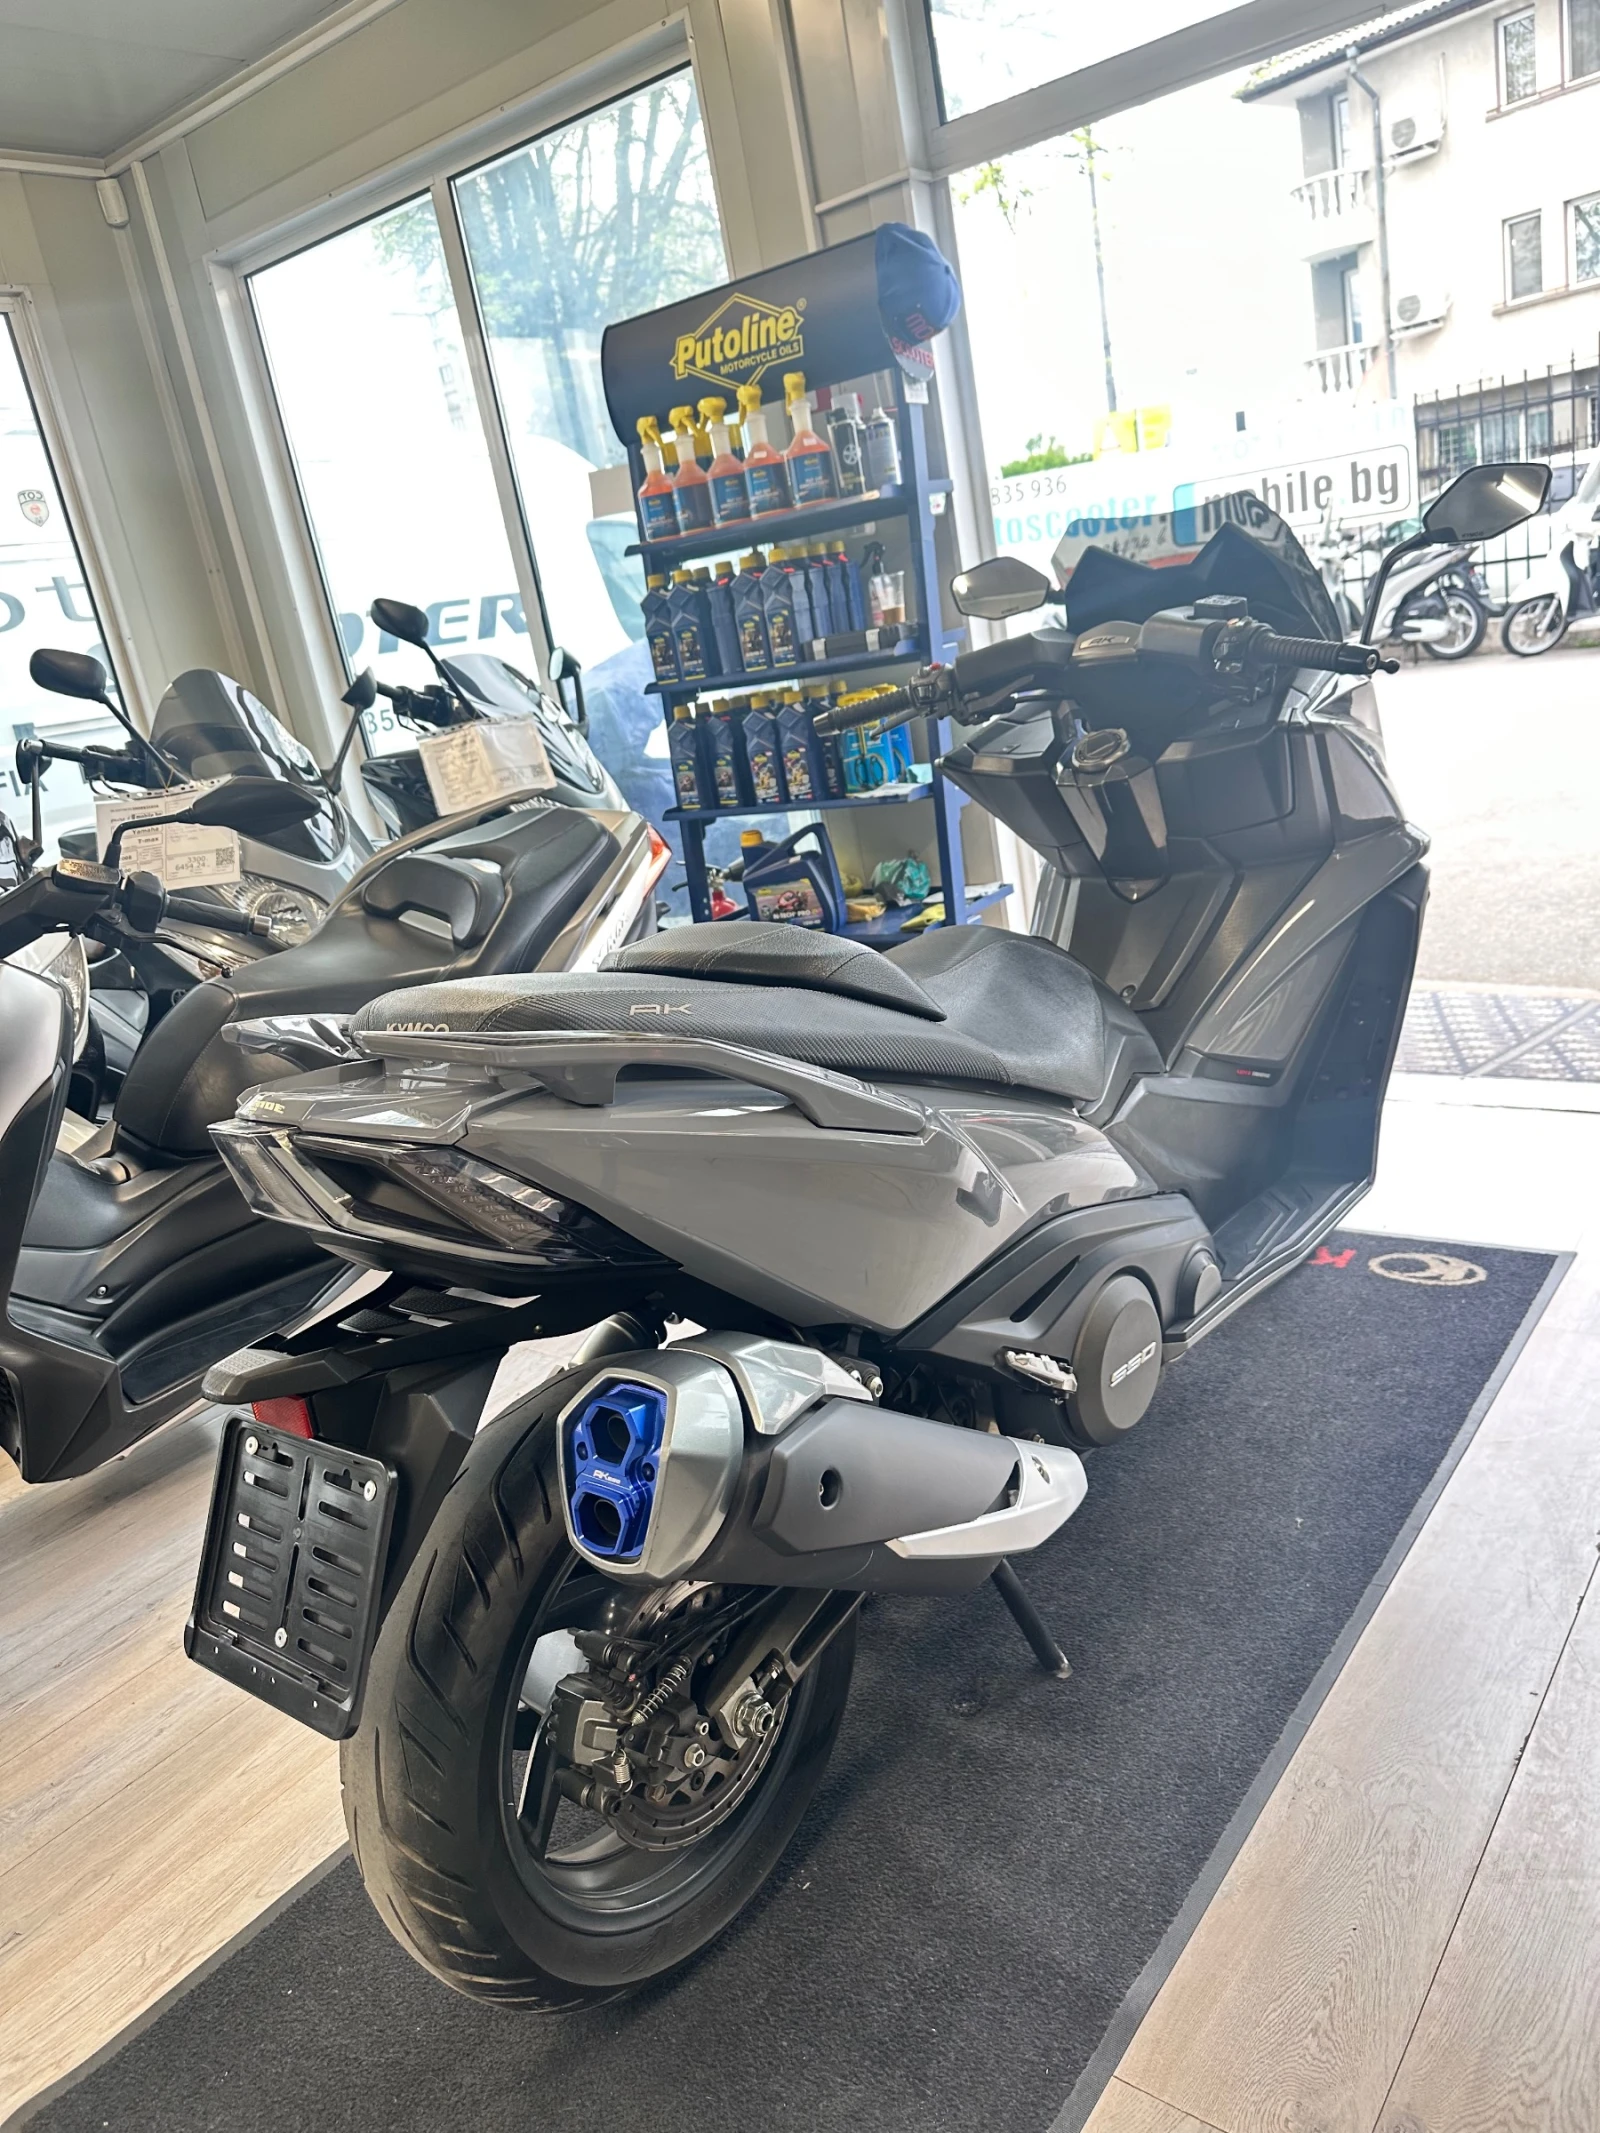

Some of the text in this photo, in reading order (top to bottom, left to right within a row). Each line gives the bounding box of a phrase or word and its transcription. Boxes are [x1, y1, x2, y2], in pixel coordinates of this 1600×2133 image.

[678, 311, 796, 375] Putoline
[720, 341, 800, 375] MOTORCYCLE OILS
[1031, 475, 1067, 498] 936
[132, 826, 159, 835] Yamaha
[137, 836, 159, 844] T-max
[630, 1003, 693, 1016] AK
[386, 1022, 450, 1033] KYMCO
